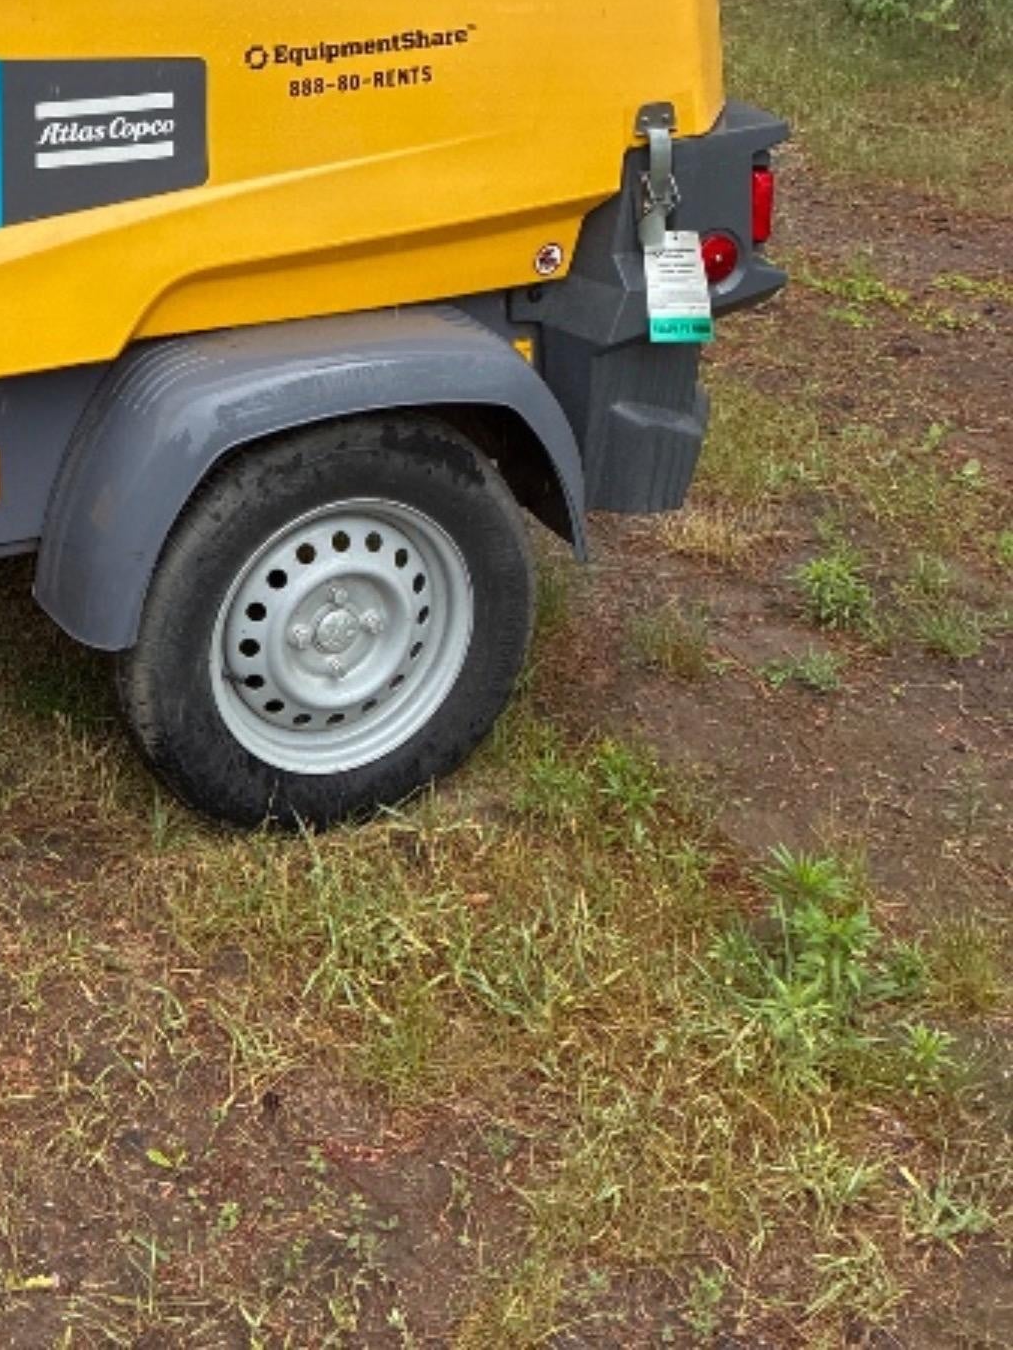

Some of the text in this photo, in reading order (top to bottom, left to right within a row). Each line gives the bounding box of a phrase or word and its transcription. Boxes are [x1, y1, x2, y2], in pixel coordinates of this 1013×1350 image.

[289, 65, 433, 97] 888-80-RENTS
[36, 116, 175, 145] Atlas Copco
